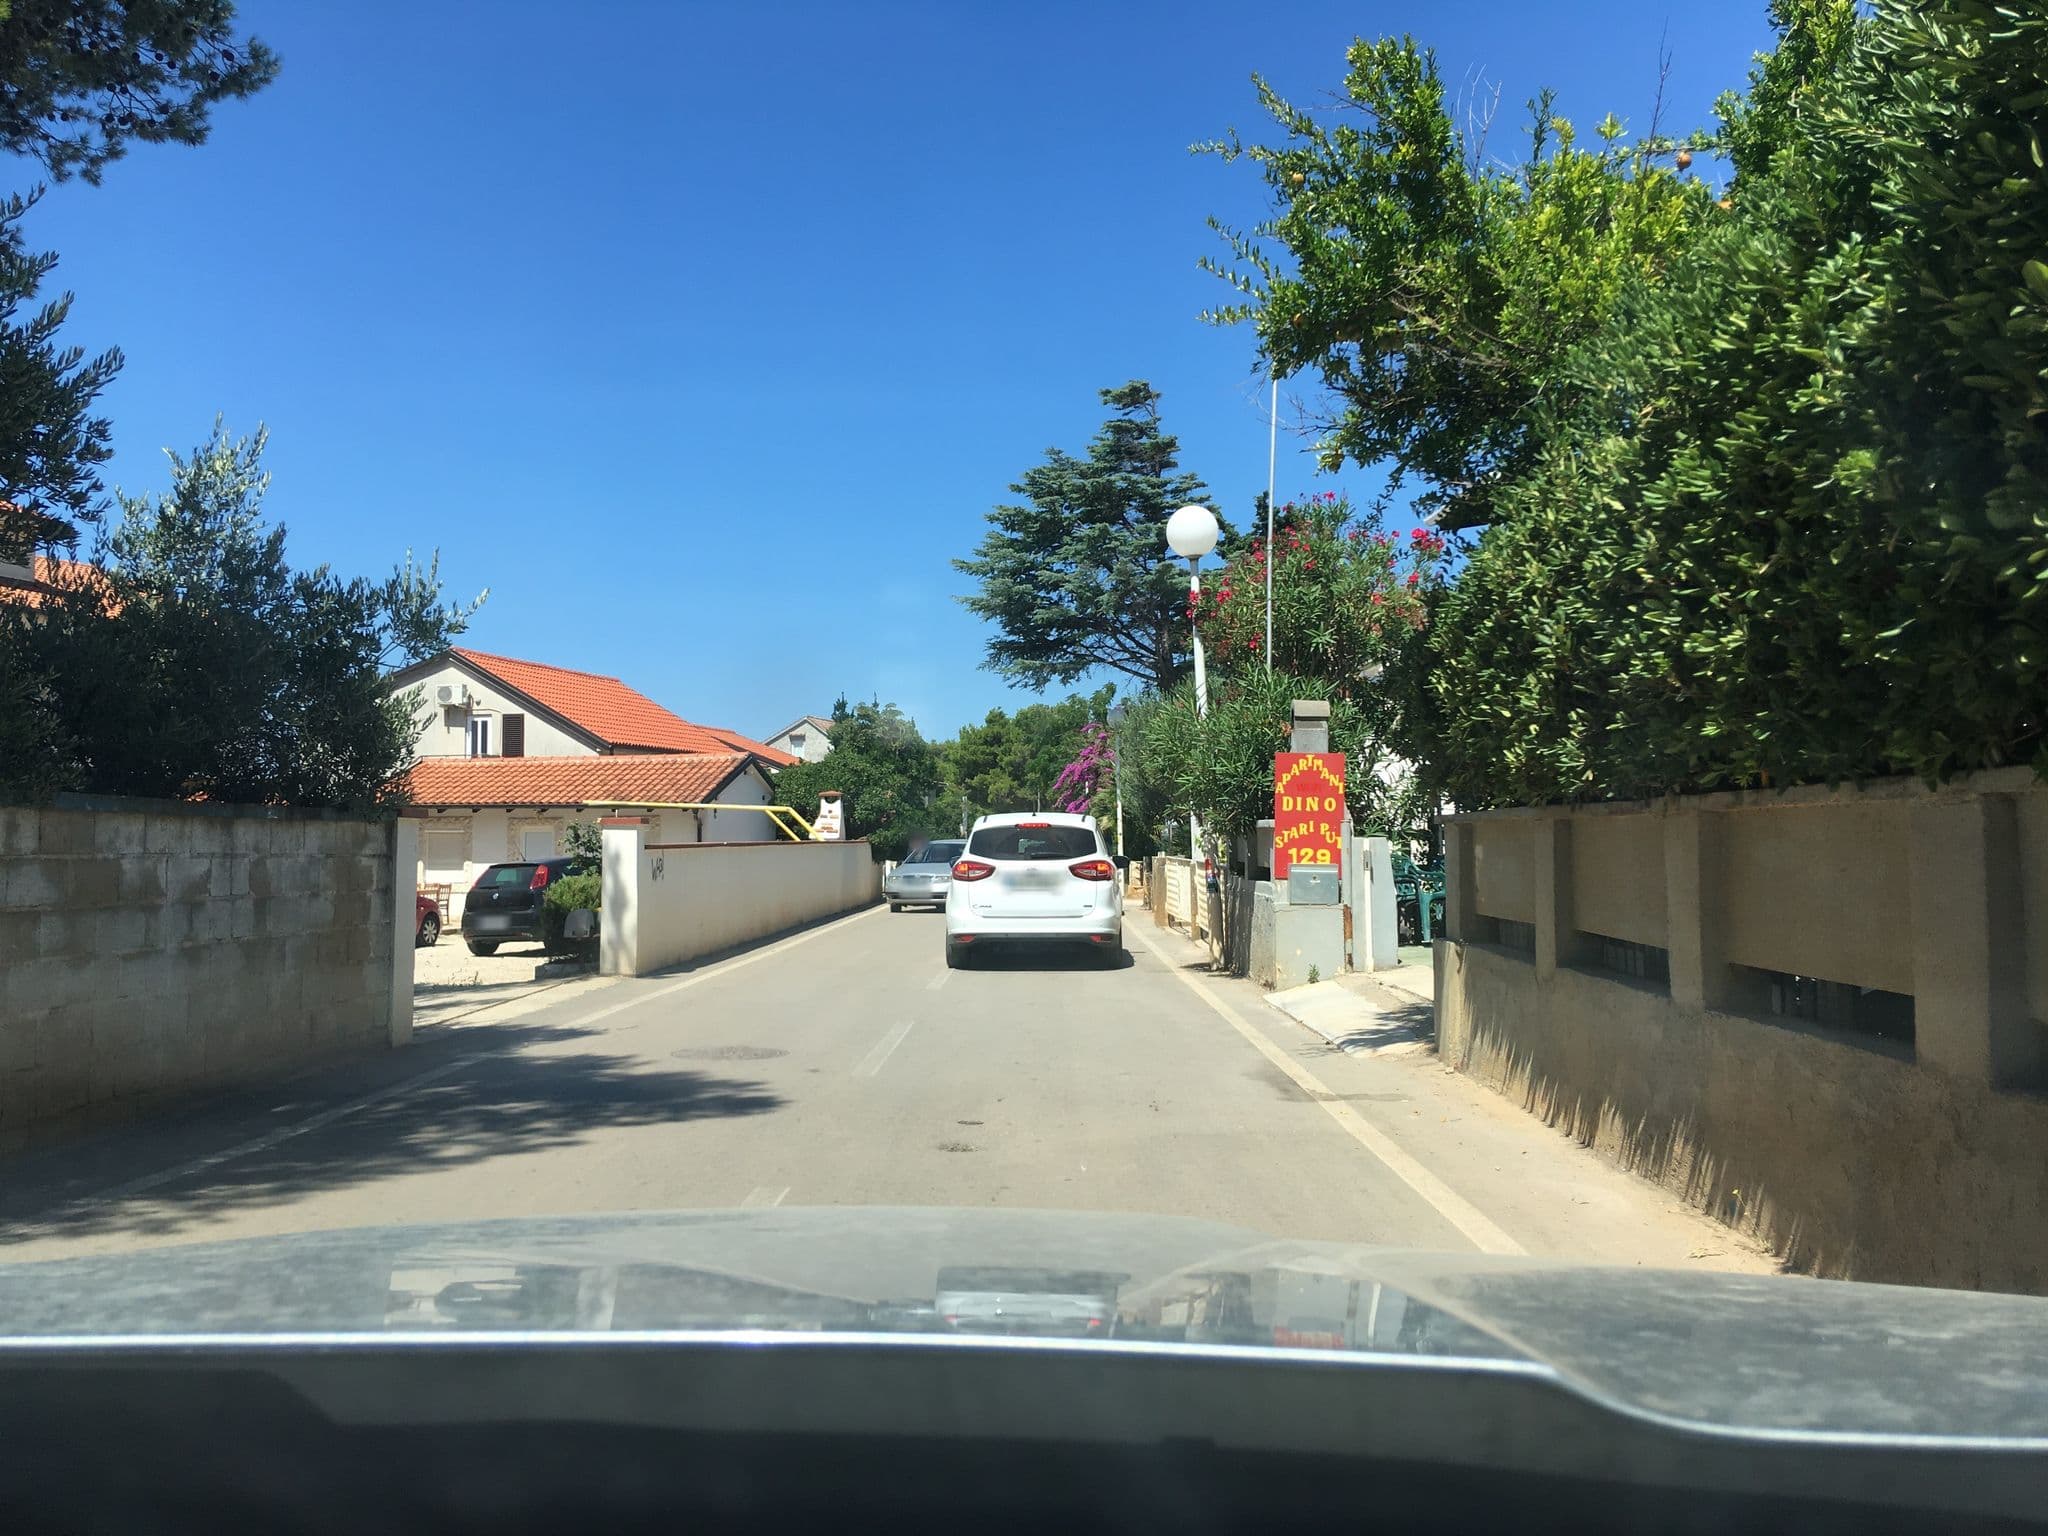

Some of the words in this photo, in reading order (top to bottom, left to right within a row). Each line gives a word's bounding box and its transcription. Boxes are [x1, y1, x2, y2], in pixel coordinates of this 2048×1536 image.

[1275, 754, 1344, 794] APARTMANI
[1282, 796, 1337, 812] DINO
[1275, 820, 1315, 849] STARI
[1320, 823, 1342, 849] PUT
[1287, 847, 1332, 865] 129
